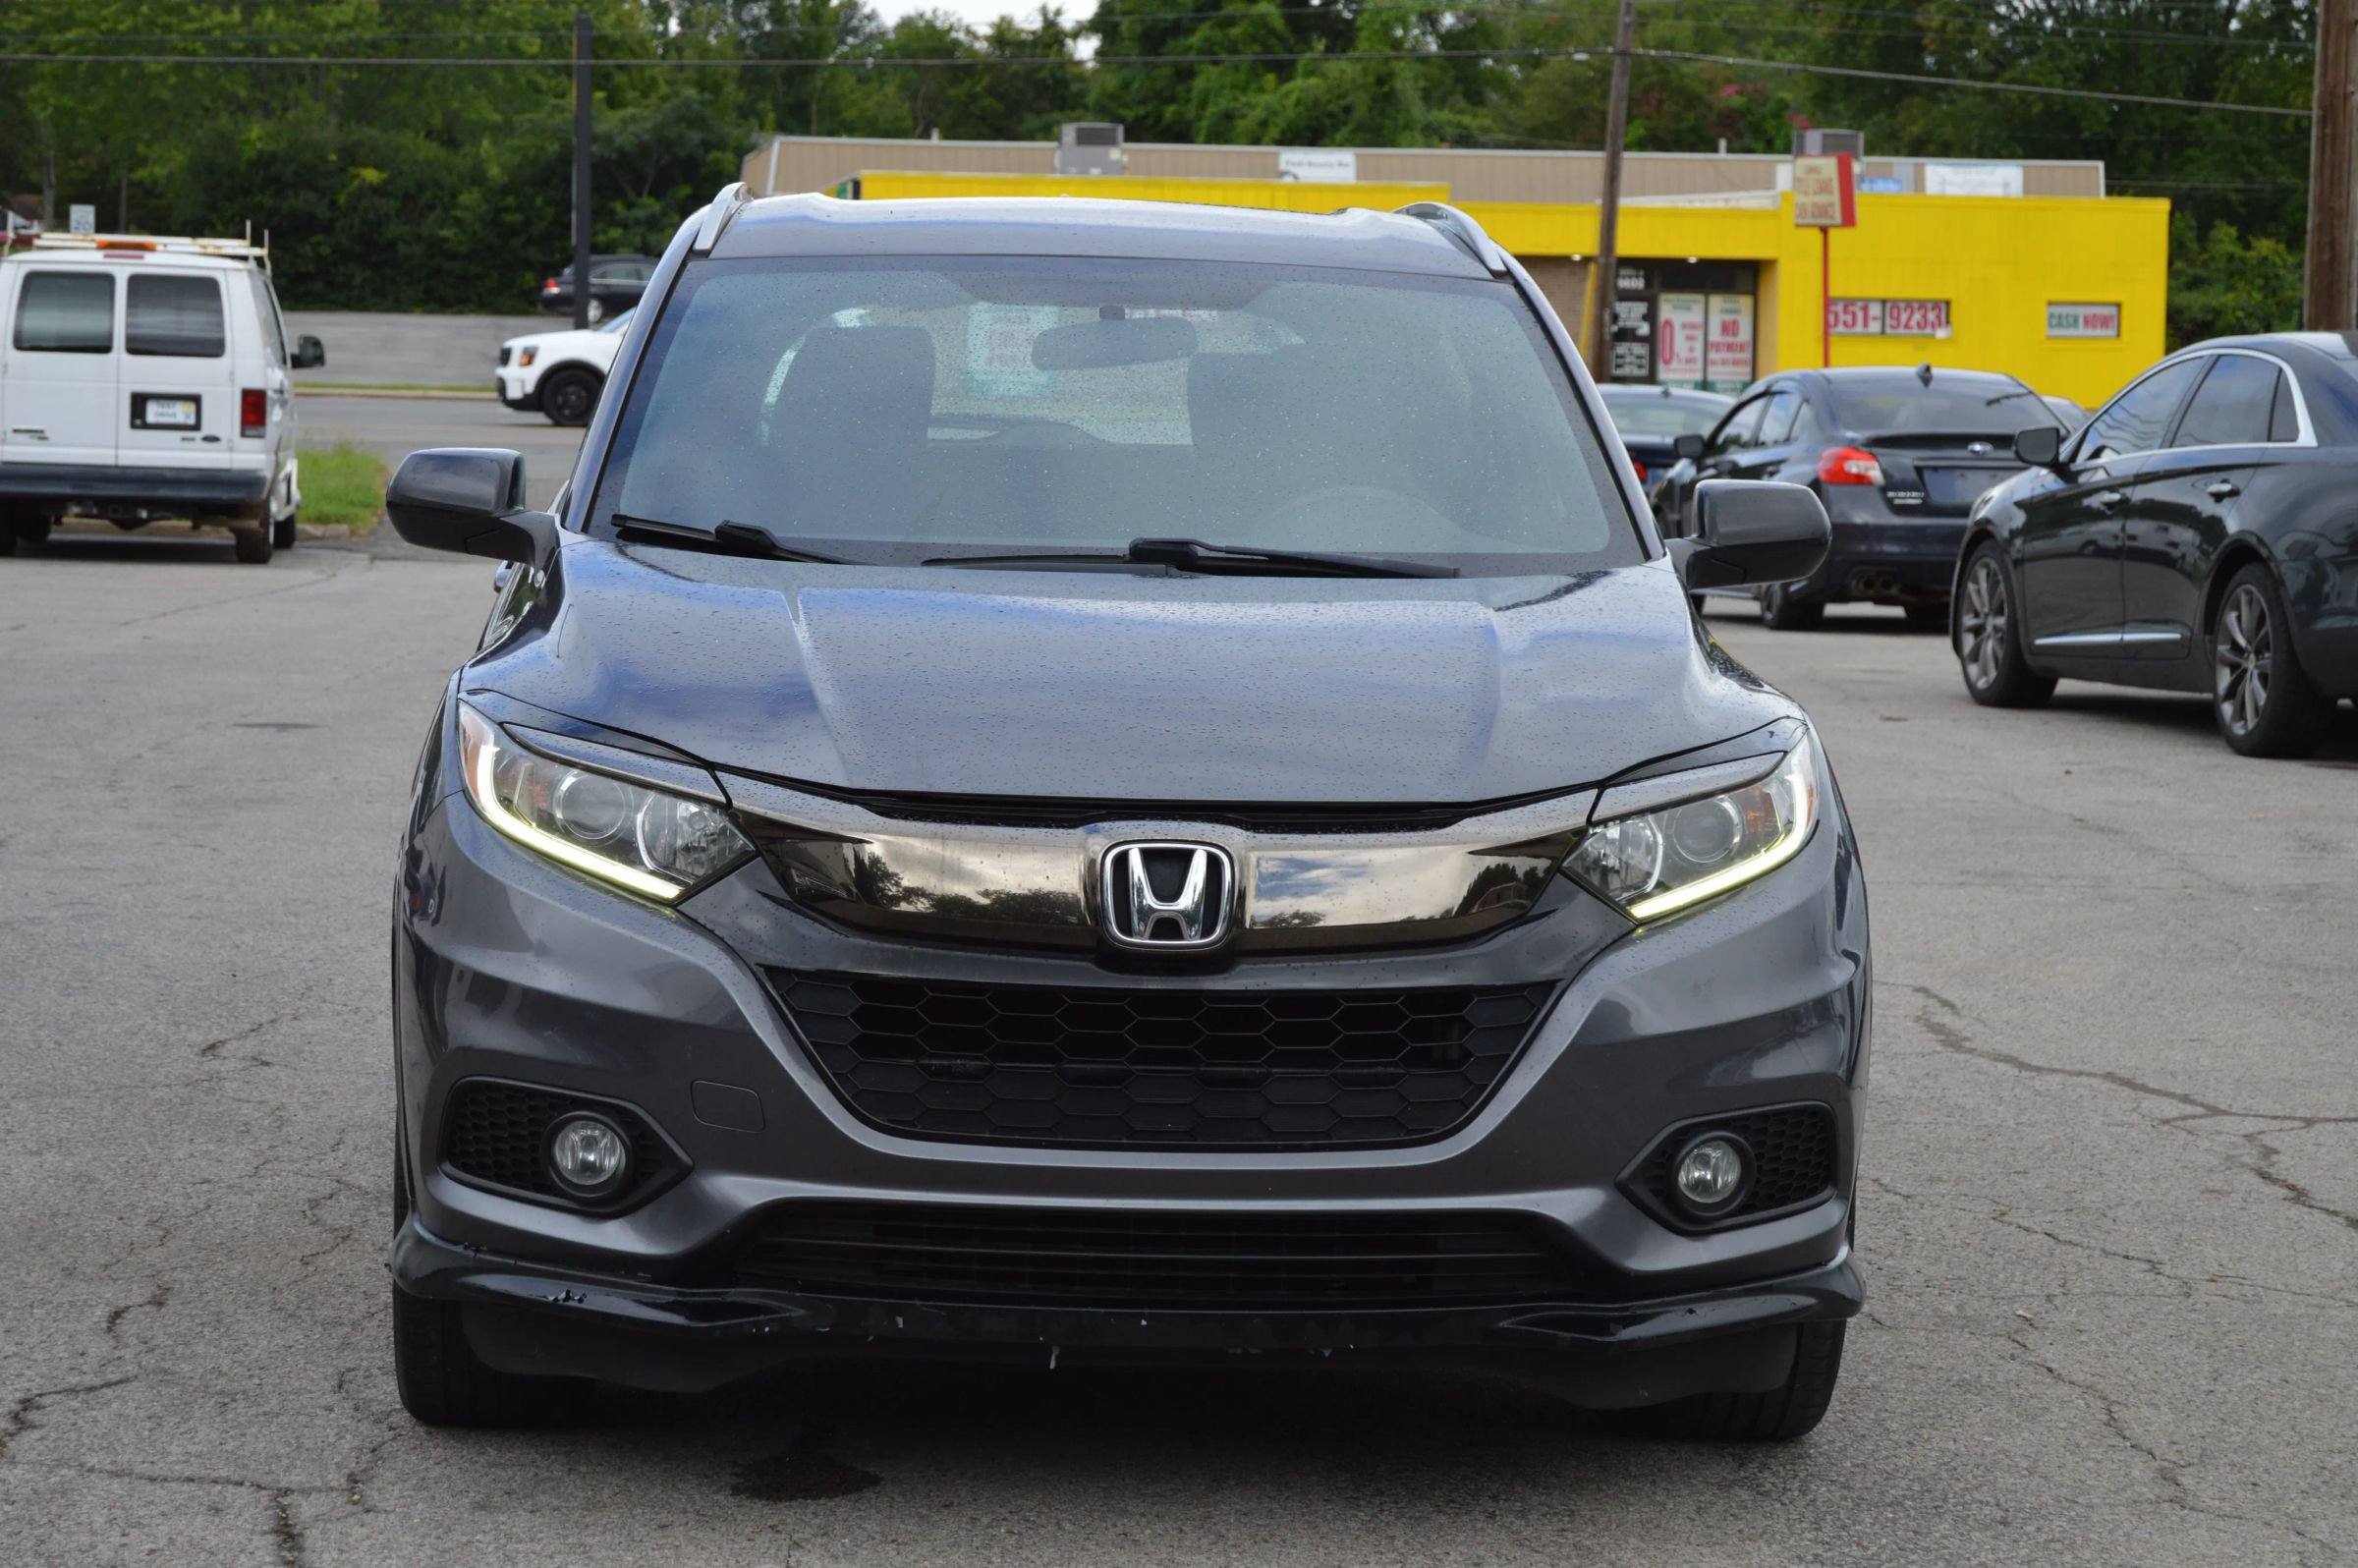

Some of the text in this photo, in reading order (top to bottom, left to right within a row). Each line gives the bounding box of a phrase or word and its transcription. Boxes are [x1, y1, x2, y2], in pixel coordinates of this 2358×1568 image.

[1888, 303, 1942, 331] 9233
[2048, 312, 2114, 331] CASH NOW!
[1720, 317, 1741, 337] NO
[1709, 341, 1751, 354] PAYMENT
